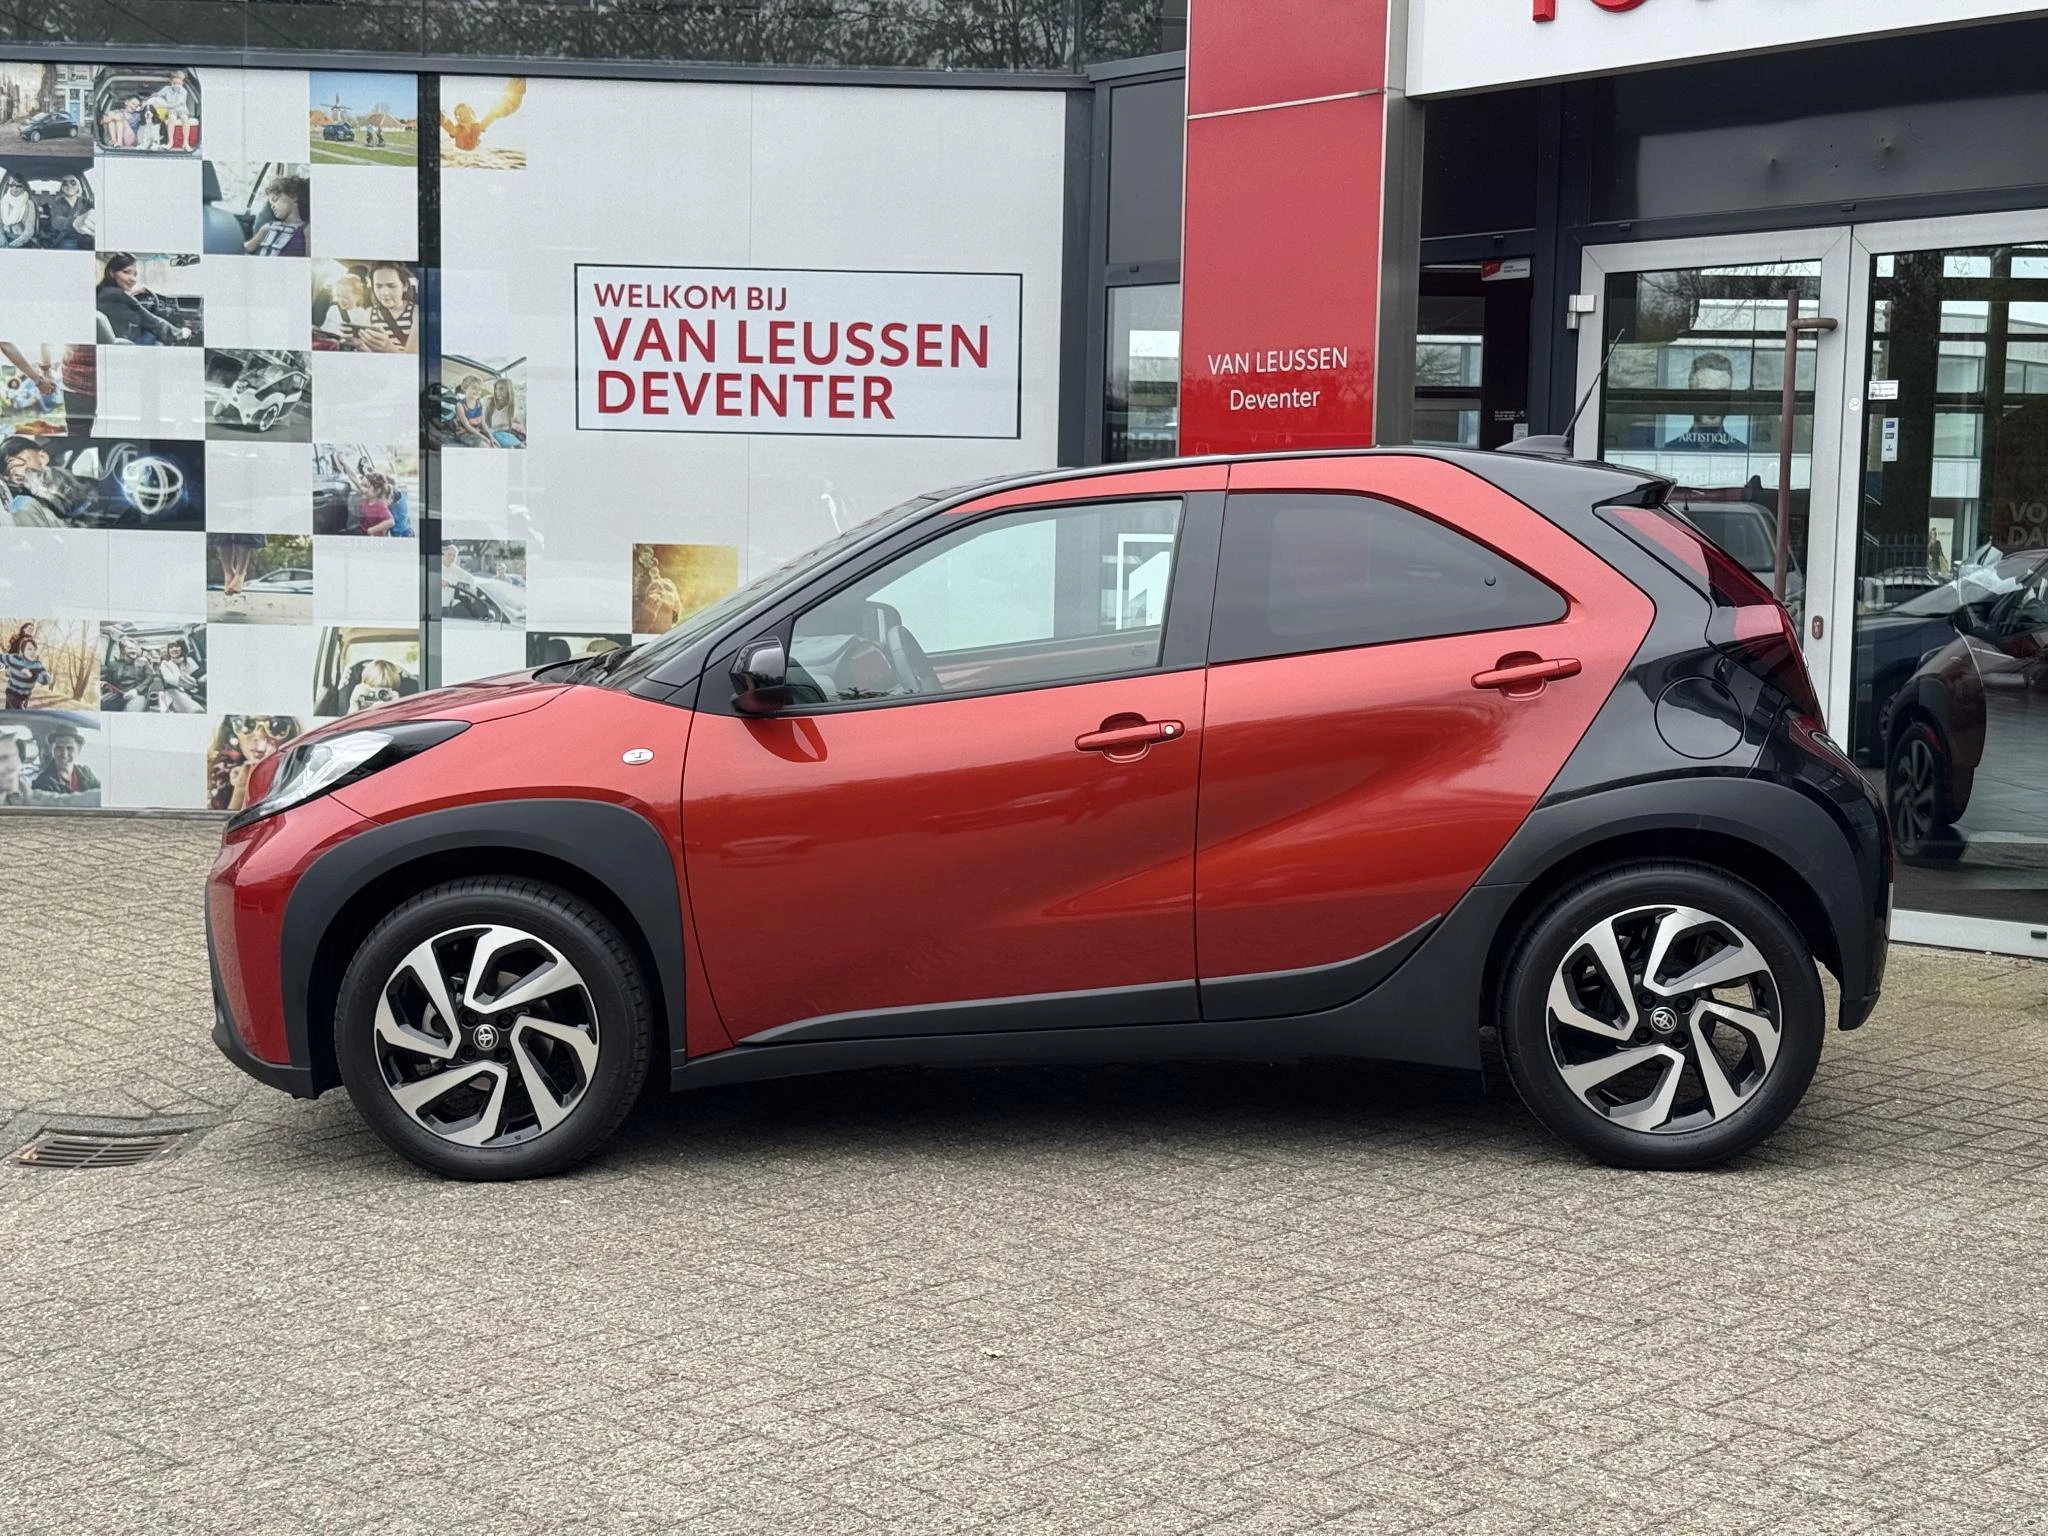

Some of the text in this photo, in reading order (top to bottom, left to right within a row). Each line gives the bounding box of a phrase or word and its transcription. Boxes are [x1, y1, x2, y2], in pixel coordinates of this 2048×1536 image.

[593, 283, 788, 312] WELKOM BIJ
[593, 316, 989, 369] VAN LEUSSEN
[1207, 346, 1349, 376] VAN LEUSSEN
[597, 369, 896, 420] DEVENTER
[1229, 387, 1321, 412] Deventer
